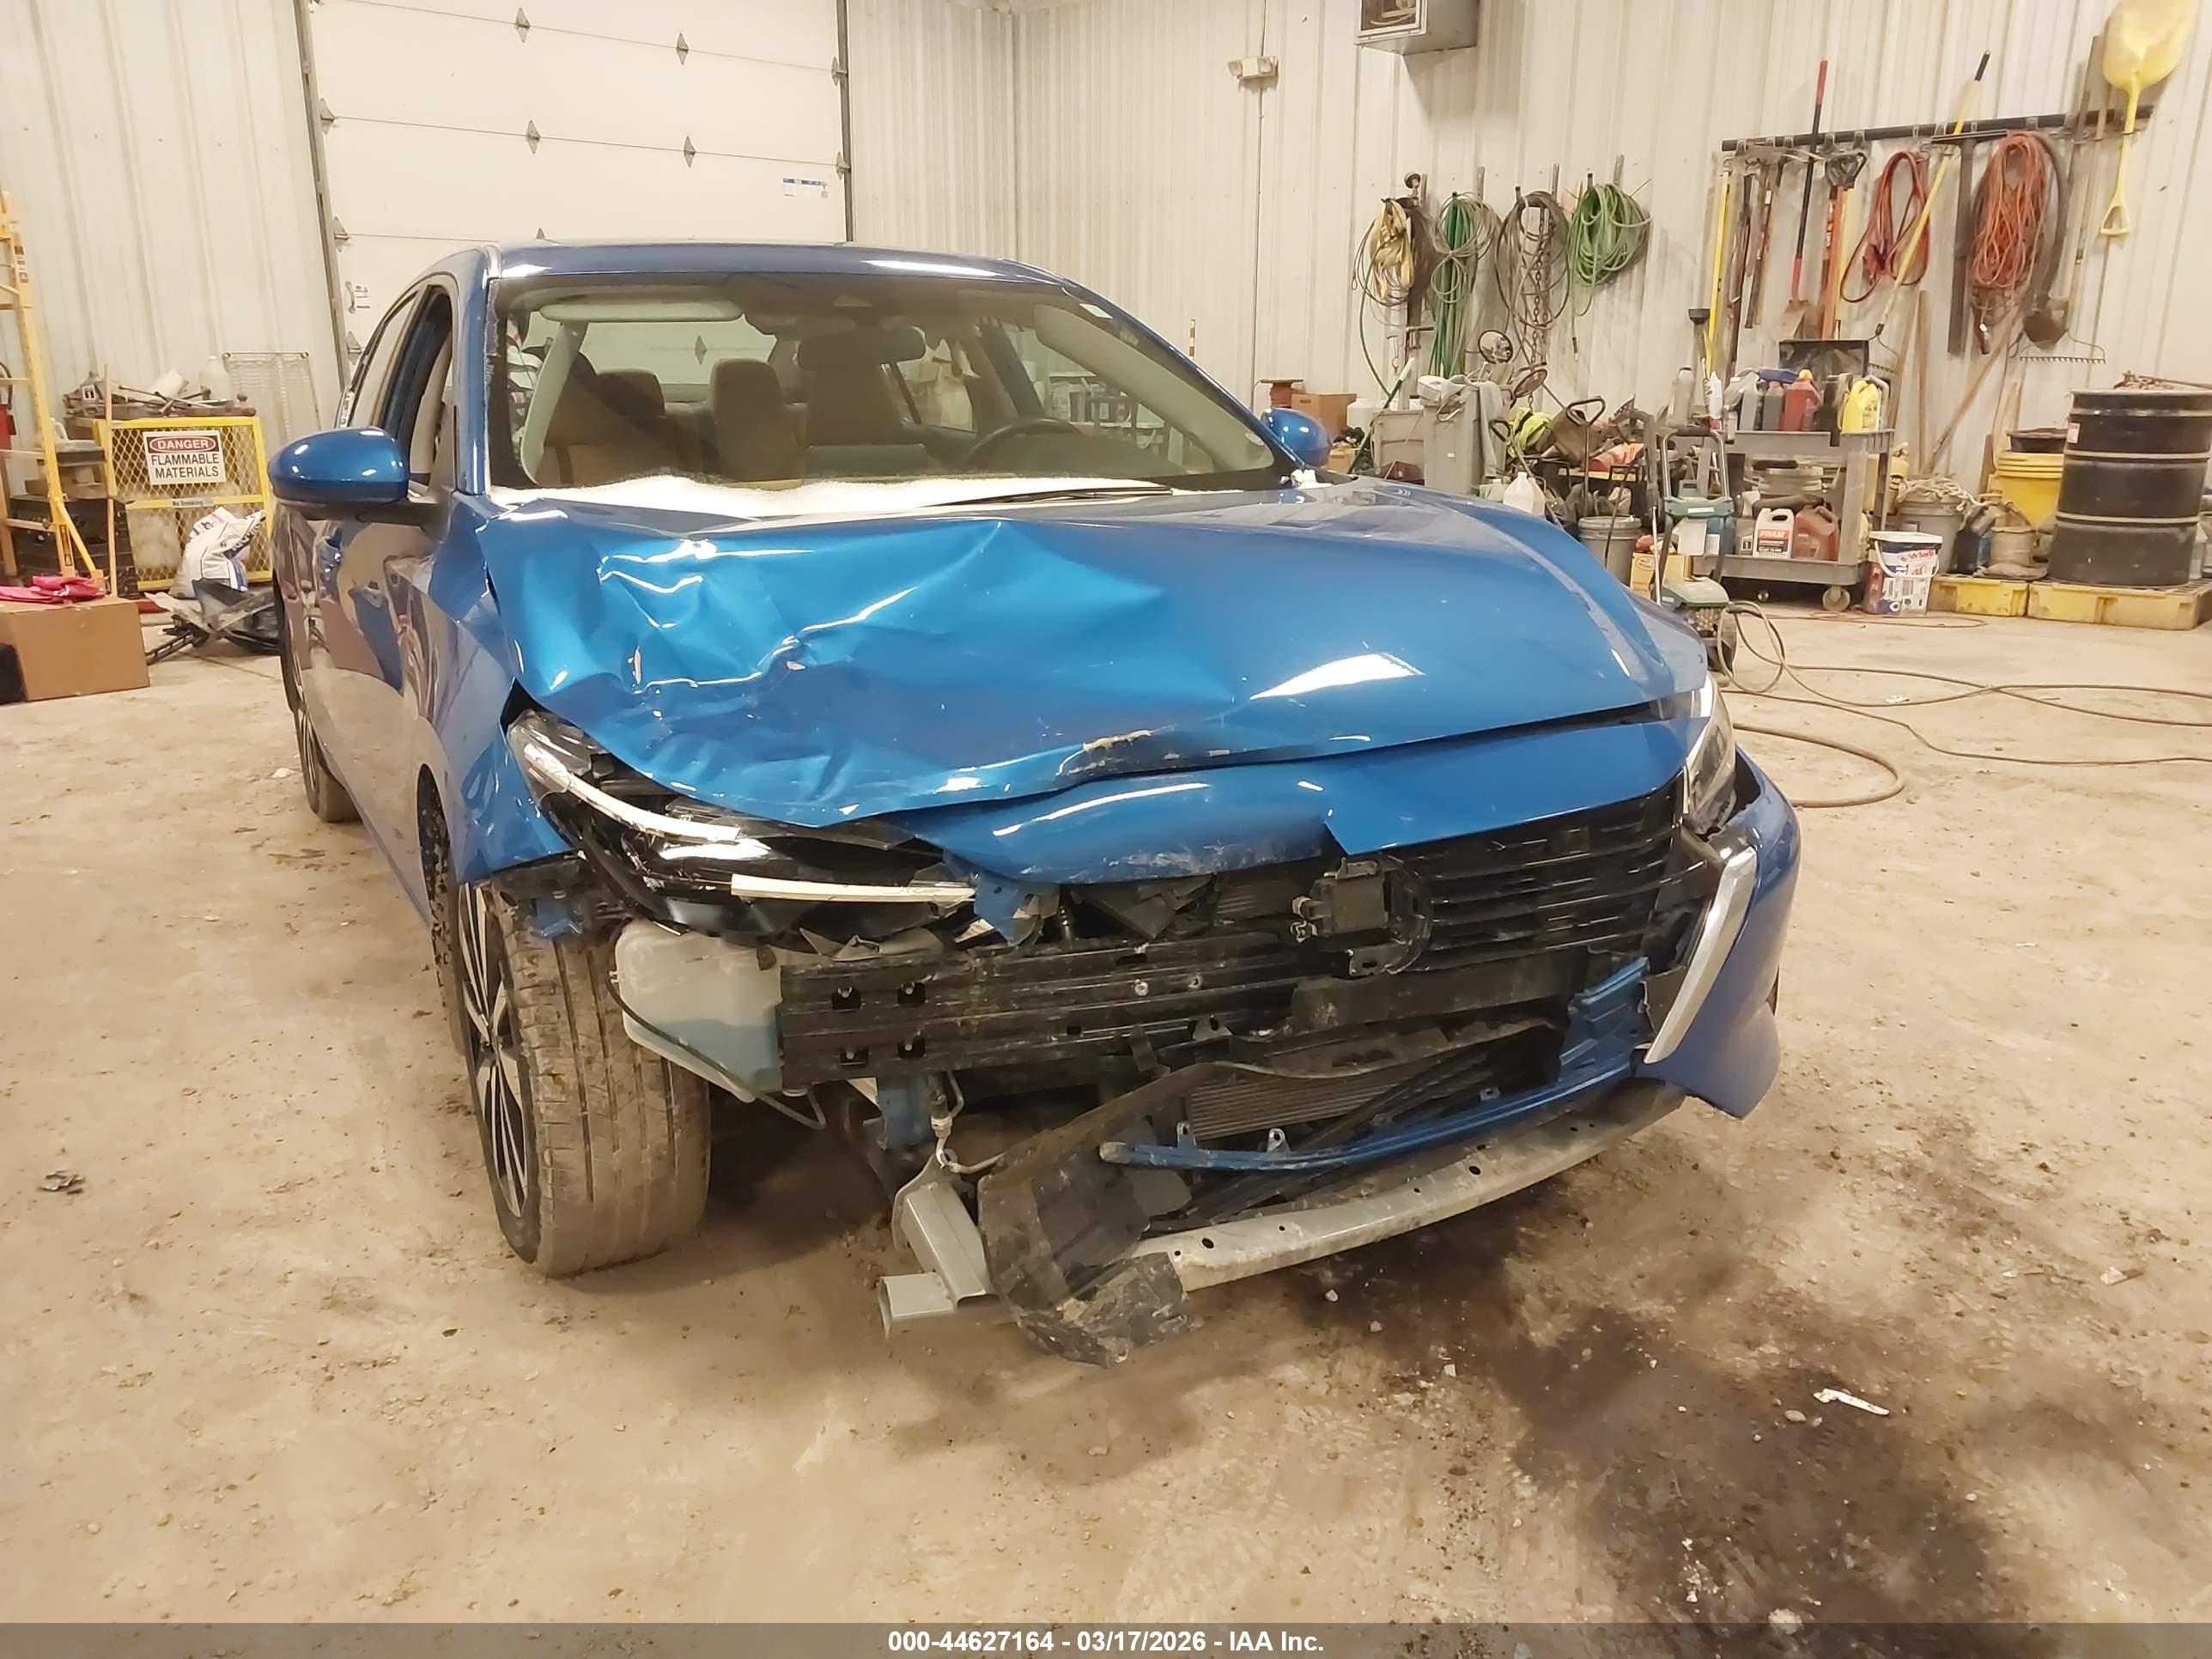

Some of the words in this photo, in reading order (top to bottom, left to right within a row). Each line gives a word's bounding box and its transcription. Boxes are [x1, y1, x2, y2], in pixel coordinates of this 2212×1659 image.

[157, 439, 209, 450] DANGER
[151, 453, 219, 465] FLAMMABLE
[155, 466, 218, 478] MATERIALS
